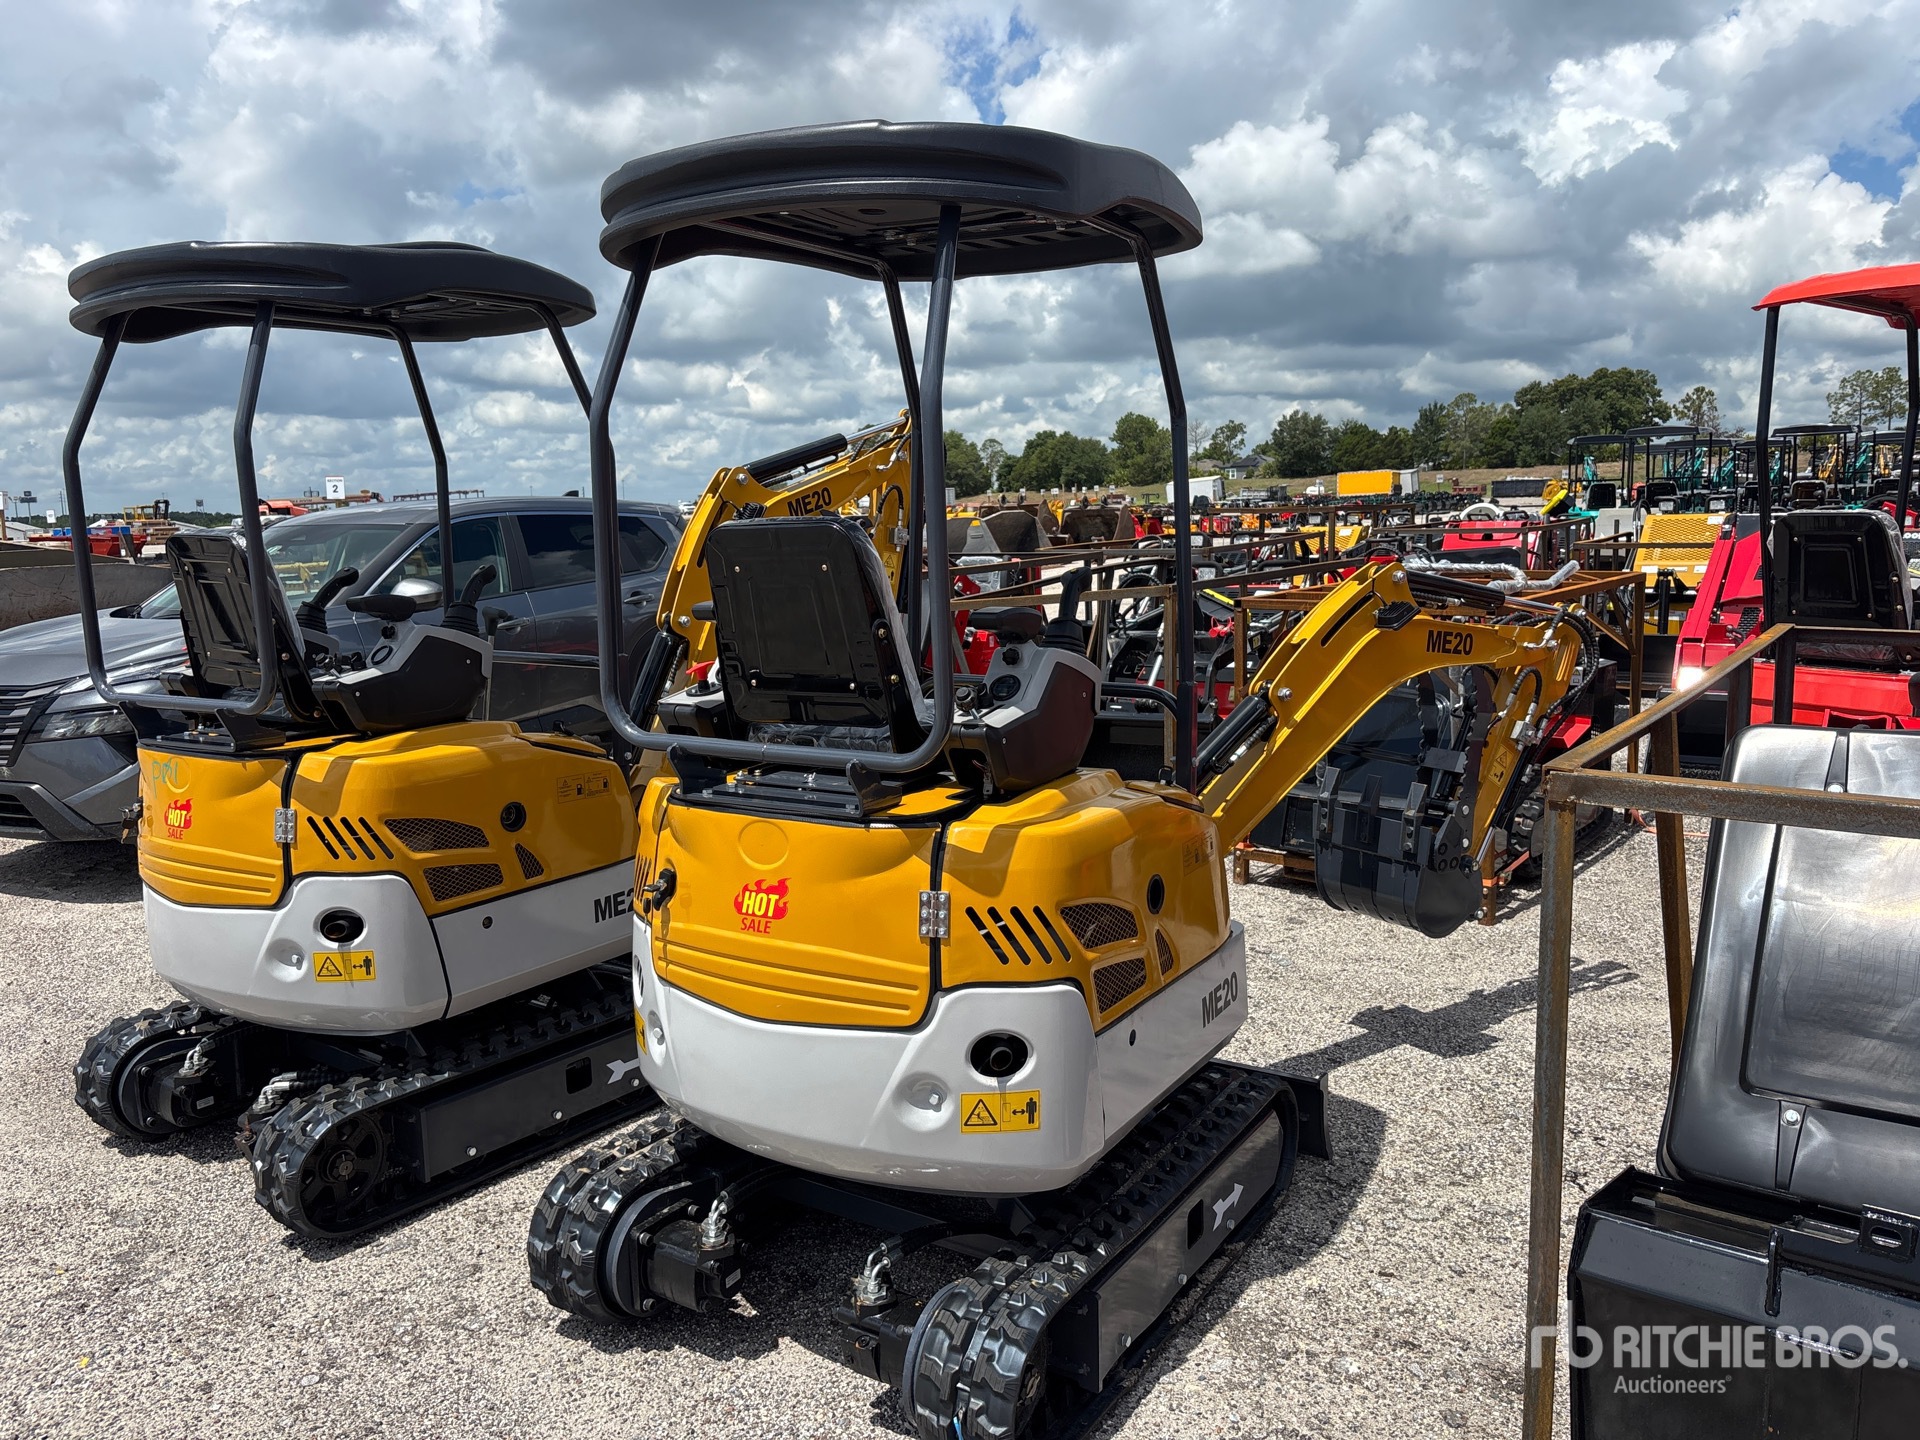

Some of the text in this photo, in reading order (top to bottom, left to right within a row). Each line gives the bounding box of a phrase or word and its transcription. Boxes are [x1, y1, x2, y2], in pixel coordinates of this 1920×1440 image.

[332, 484, 339, 493] 2
[787, 487, 831, 517] ME20
[1426, 629, 1474, 656] ME20
[167, 808, 187, 828] HOT
[167, 827, 184, 840] SALE
[741, 890, 780, 918] HOT
[740, 916, 773, 935] SALE
[1201, 971, 1239, 1029] ME20
